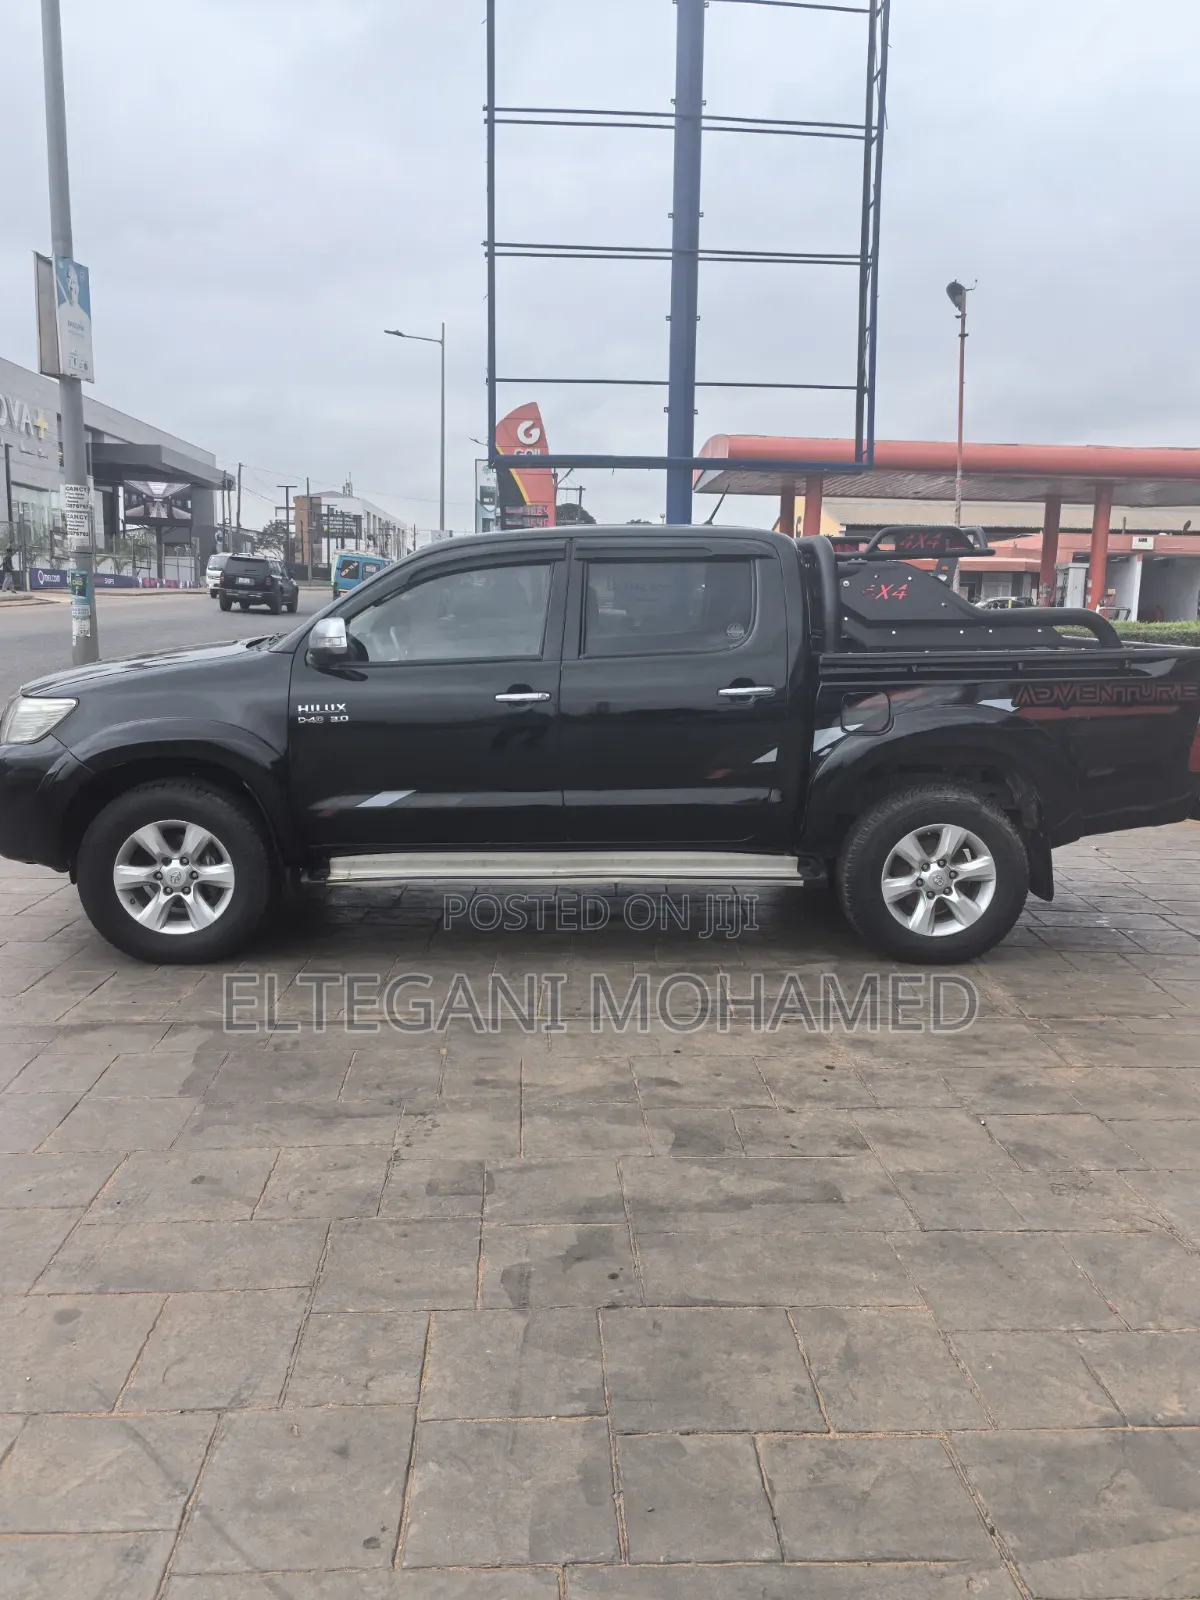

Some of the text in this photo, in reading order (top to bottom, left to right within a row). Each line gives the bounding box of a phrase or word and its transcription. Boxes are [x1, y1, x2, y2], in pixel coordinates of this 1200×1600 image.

[900, 533, 941, 549] 4X4
[1013, 682, 1199, 706] ADVENTURE
[297, 703, 347, 713] HILUX
